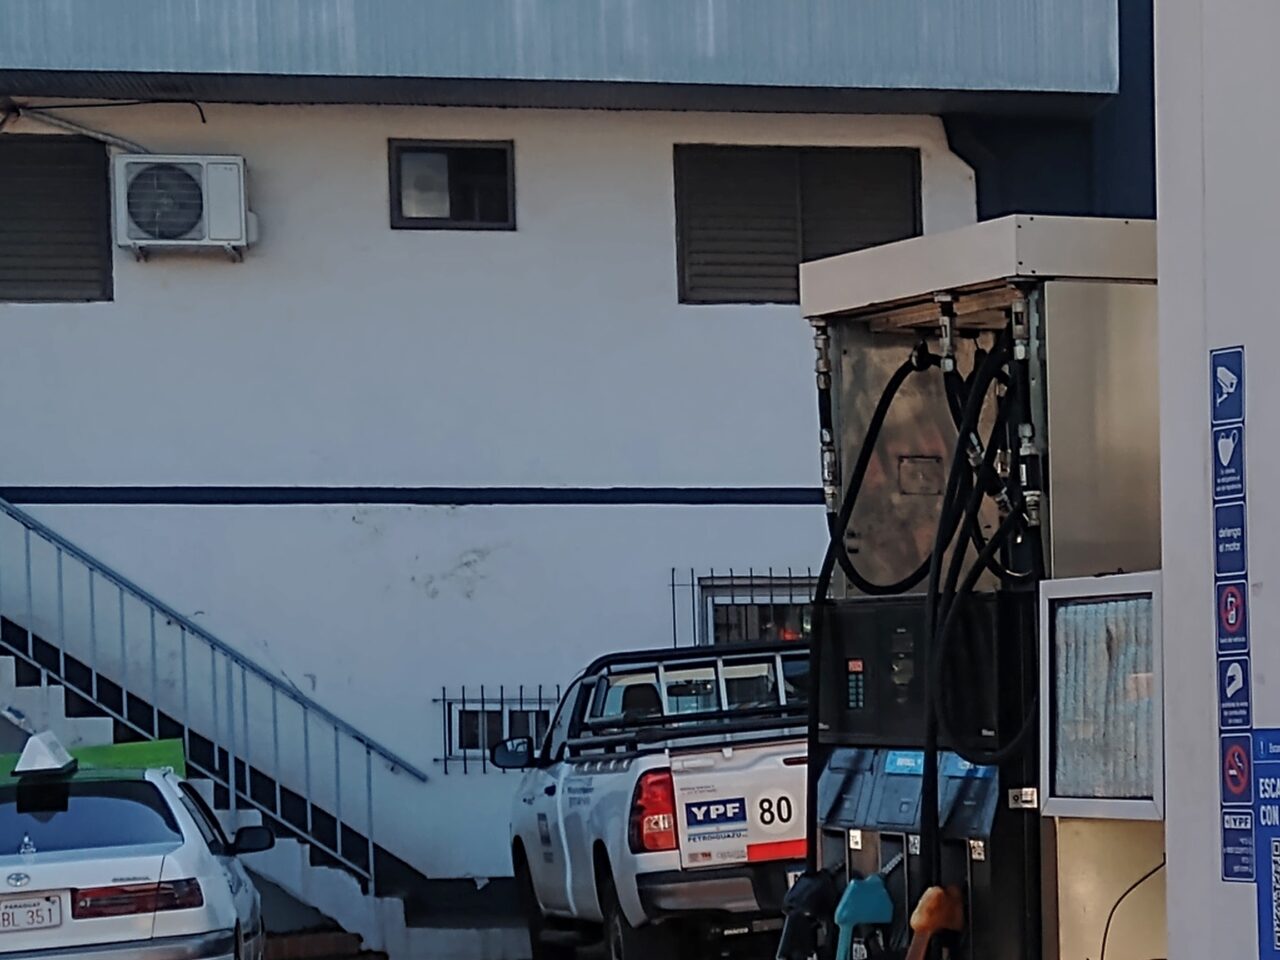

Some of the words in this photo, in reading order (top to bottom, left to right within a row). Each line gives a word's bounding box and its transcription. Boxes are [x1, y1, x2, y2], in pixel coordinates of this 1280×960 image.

[690, 803, 740, 820] YPF
[759, 796, 793, 825] 80
[1260, 805, 1279, 826] CON
[1232, 817, 1249, 827] YPF
[4, 902, 41, 910] PARAGUAY
[26, 908, 54, 926] 351
